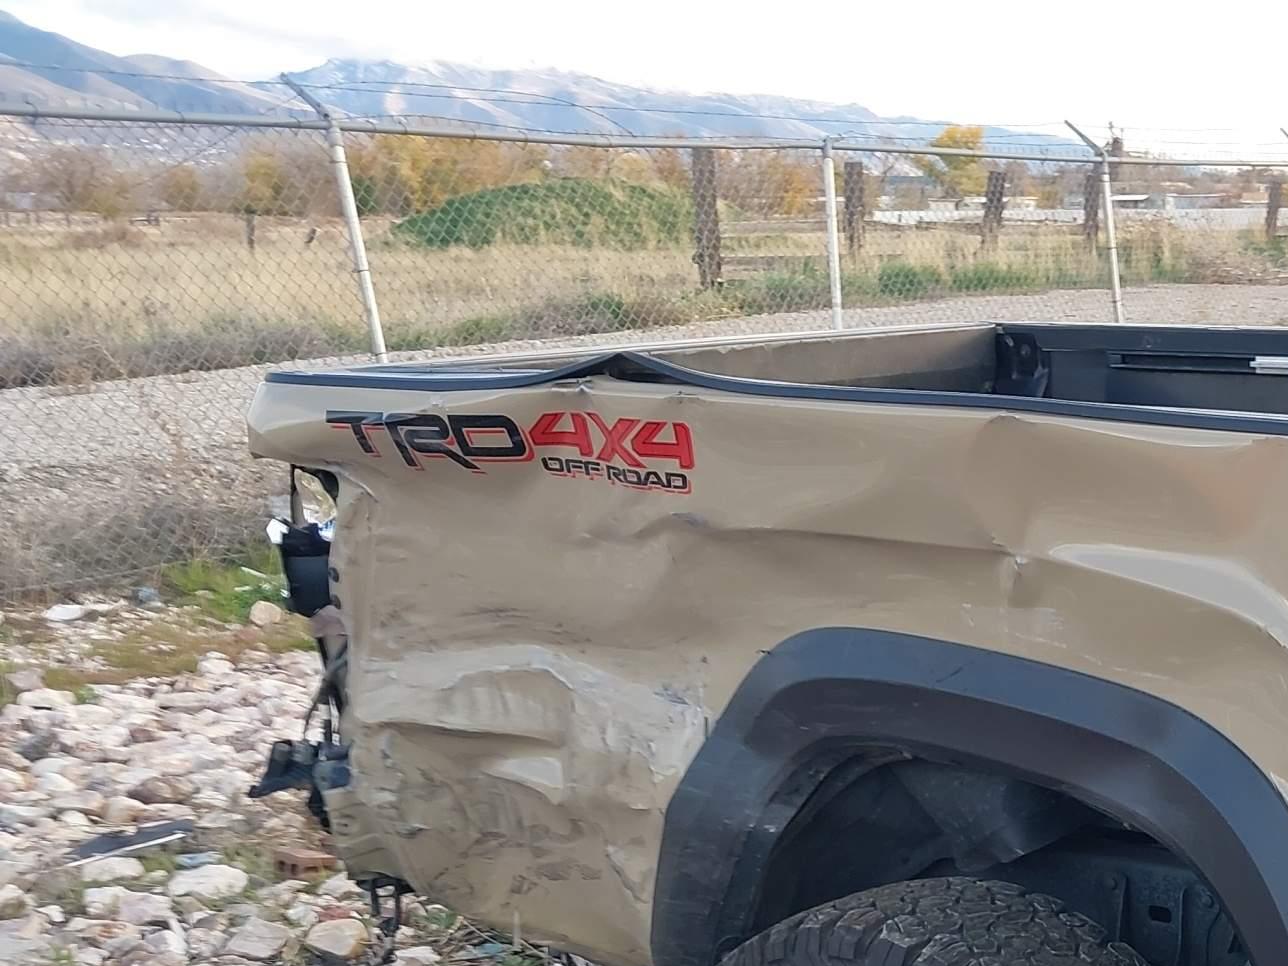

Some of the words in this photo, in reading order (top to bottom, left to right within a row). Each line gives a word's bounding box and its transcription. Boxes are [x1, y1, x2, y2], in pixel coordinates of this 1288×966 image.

[326, 410, 534, 474] TRD
[541, 456, 602, 479] OFF
[605, 464, 691, 494] ROAD
